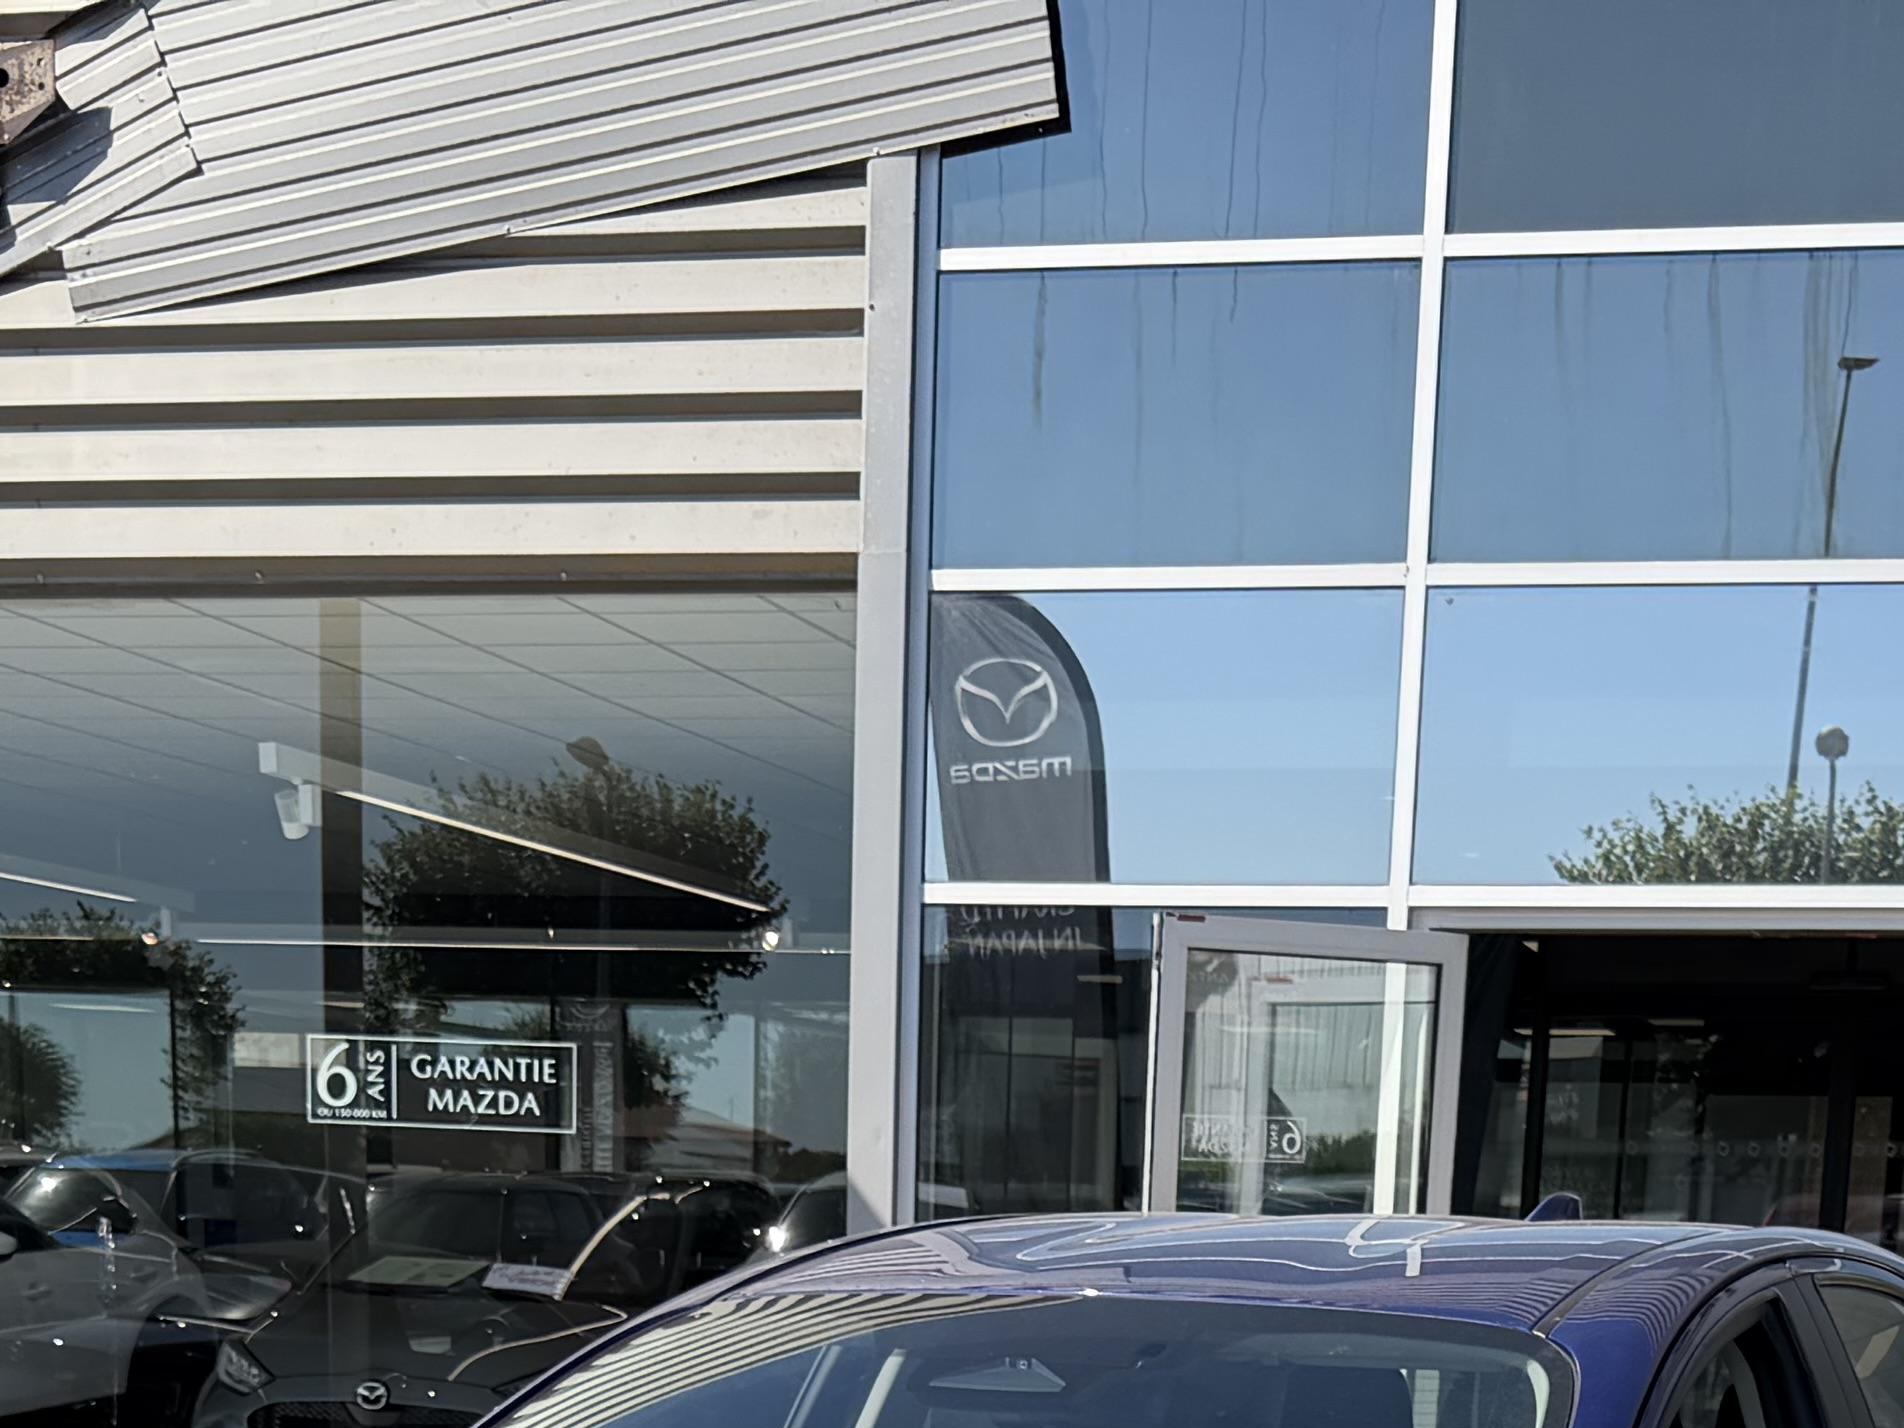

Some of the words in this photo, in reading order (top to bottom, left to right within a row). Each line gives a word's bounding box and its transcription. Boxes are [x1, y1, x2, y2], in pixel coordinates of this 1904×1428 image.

[316, 1042, 358, 1107] 6
[366, 1050, 385, 1102] ANS
[410, 1053, 557, 1084] GARANTIE
[427, 1088, 541, 1117] MAZDA
